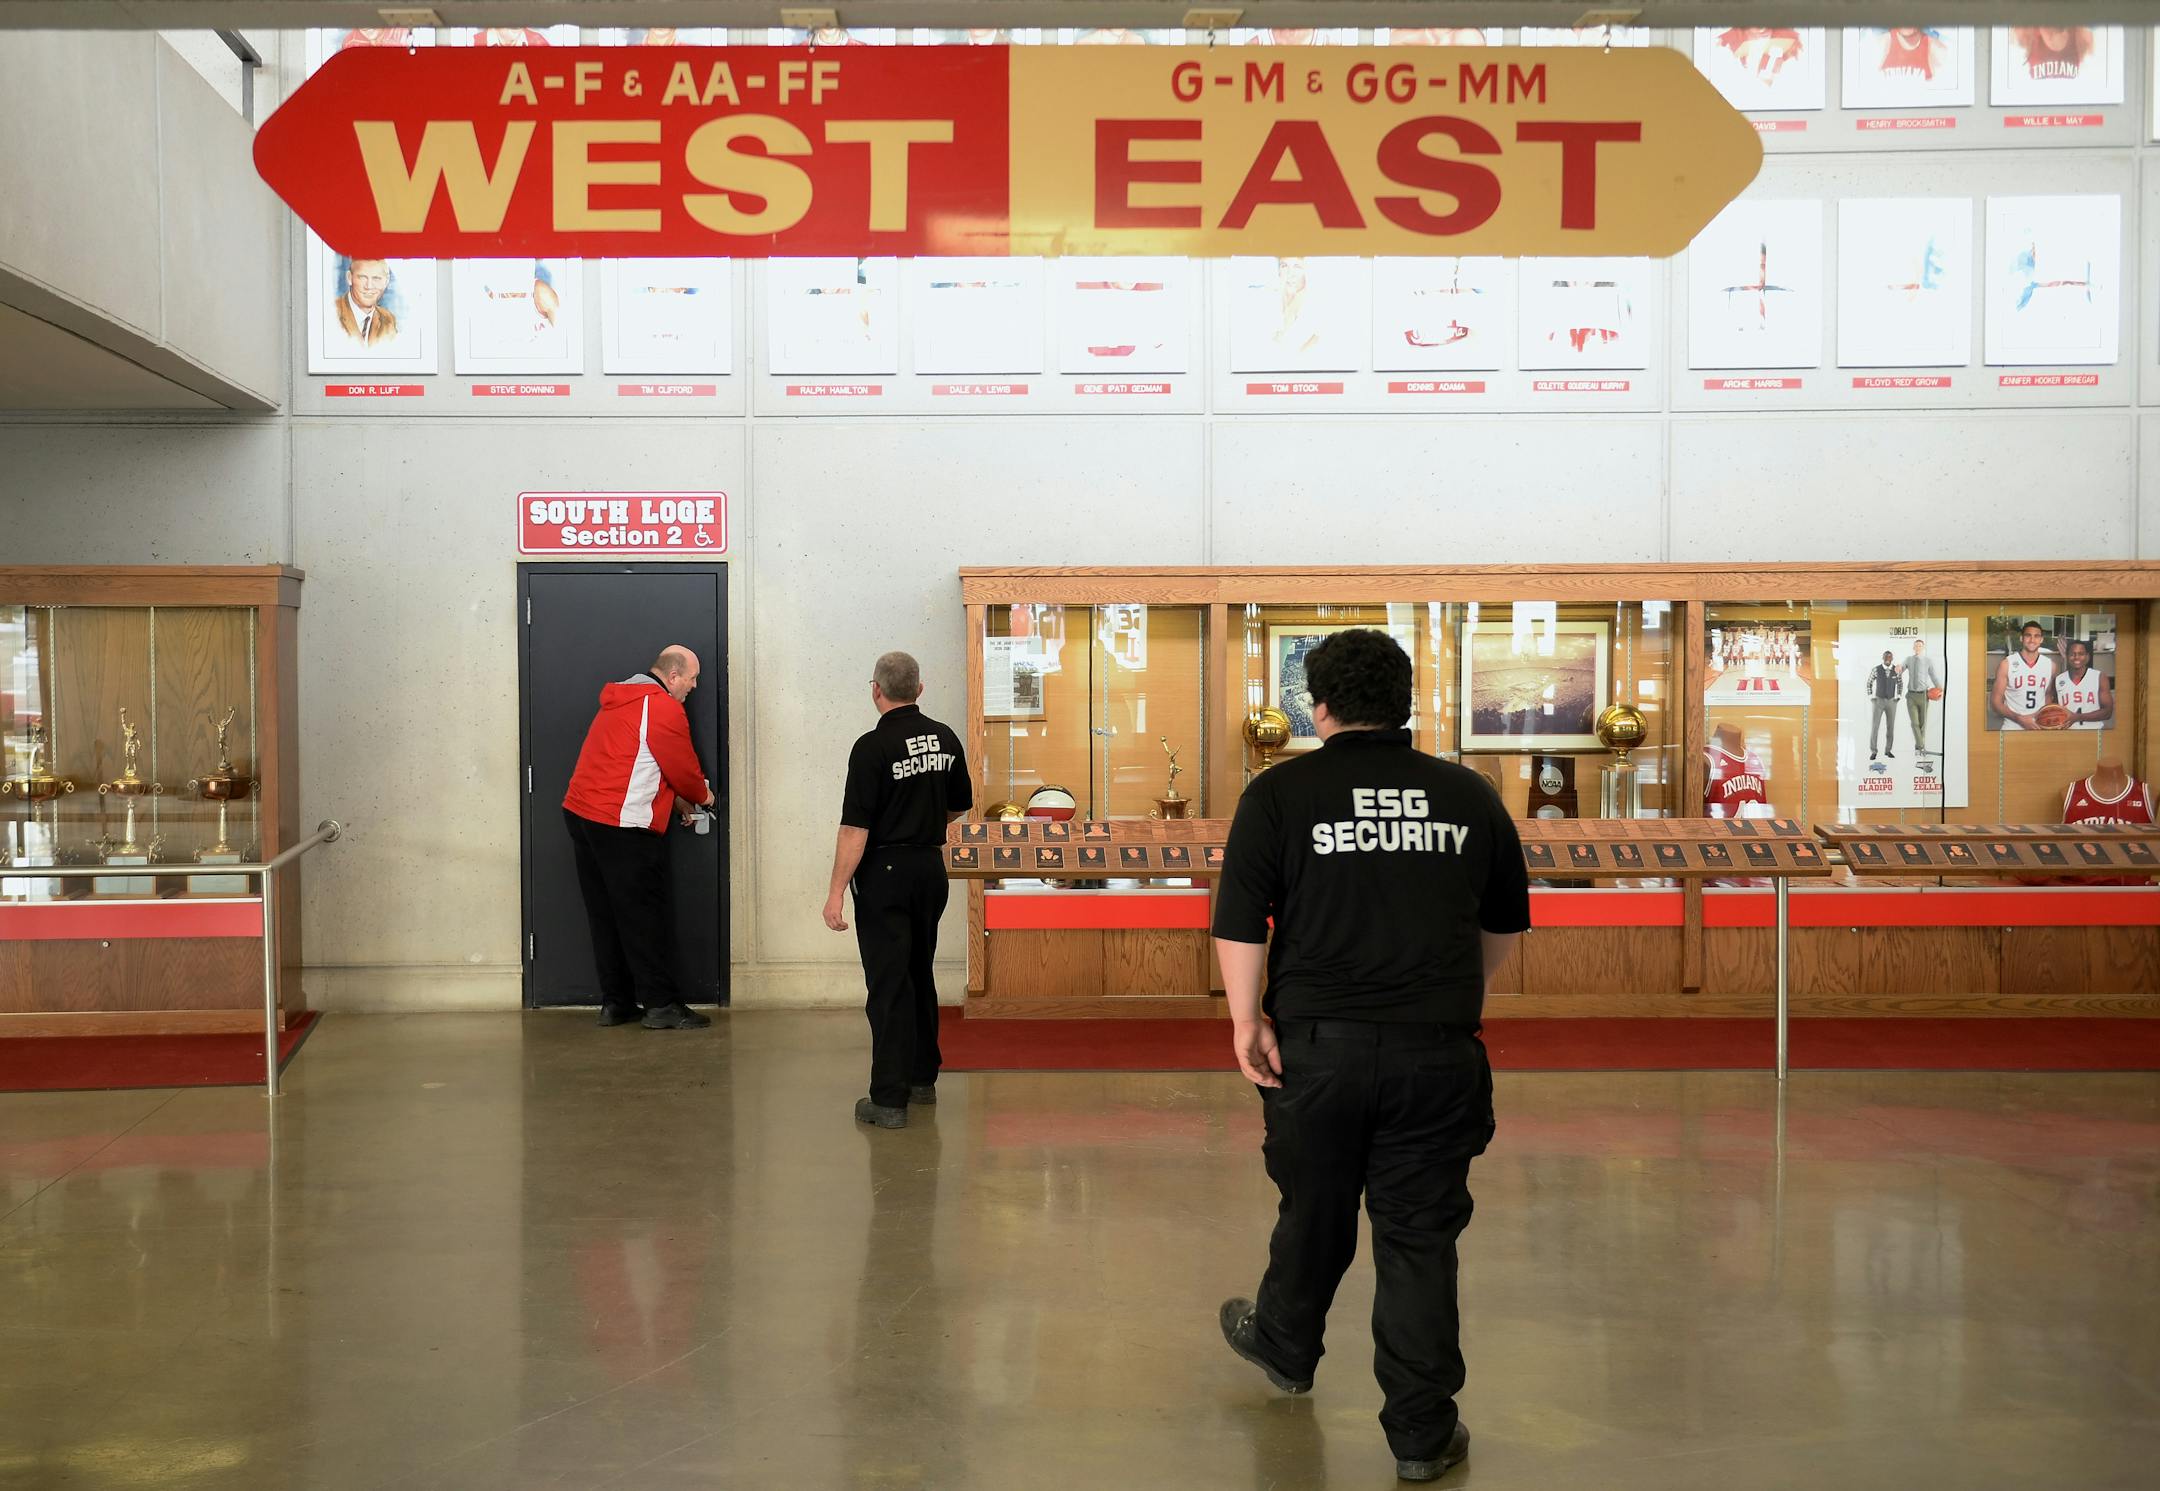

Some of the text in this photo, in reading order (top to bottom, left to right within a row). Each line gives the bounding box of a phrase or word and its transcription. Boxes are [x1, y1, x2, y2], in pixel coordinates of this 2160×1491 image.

[499, 61, 841, 105] A-F & AA-FF
[1171, 61, 1548, 105] G-M & GG-MM
[1866, 118, 1946, 128] HENRY BROCKSMITH
[2023, 117, 2049, 126] WILLIE
[2066, 116, 2084, 125] MAY
[353, 114, 955, 237] WEST
[1094, 115, 1642, 237] EAST
[1722, 379, 1783, 388] ARCHIE HARRIS
[1864, 378, 1891, 387] FLOYD
[1915, 377, 1939, 386] GROW
[2001, 376, 2031, 385] JENNIFER
[348, 386, 365, 395] DON
[380, 386, 400, 395] LUFT
[490, 386, 555, 395] STEVE DOWNING
[641, 385, 654, 394] TIM
[800, 386, 868, 395] RALPH HAMILTON
[949, 385, 970, 394] DALE
[986, 385, 1011, 394] LEWIS
[1271, 383, 1319, 393] TOM STOCK
[529, 500, 715, 525] SOUTH LOGE
[560, 526, 683, 546] Section 2
[1893, 626, 1911, 636] DRAFT
[2014, 674, 2047, 689] USA
[2026, 691, 2036, 709] 5
[2062, 691, 2095, 707] USA
[905, 734, 941, 756] ESG
[892, 753, 956, 780] SECURITY
[1541, 779, 1561, 788] NCAA
[1863, 777, 1893, 785] VICTOR
[1913, 776, 1937, 784] CODY
[1722, 774, 1763, 799] INDIANA
[1858, 784, 1893, 792] OLADIPO
[1352, 788, 1429, 818] ESG
[1312, 820, 1469, 855] SECURITY
